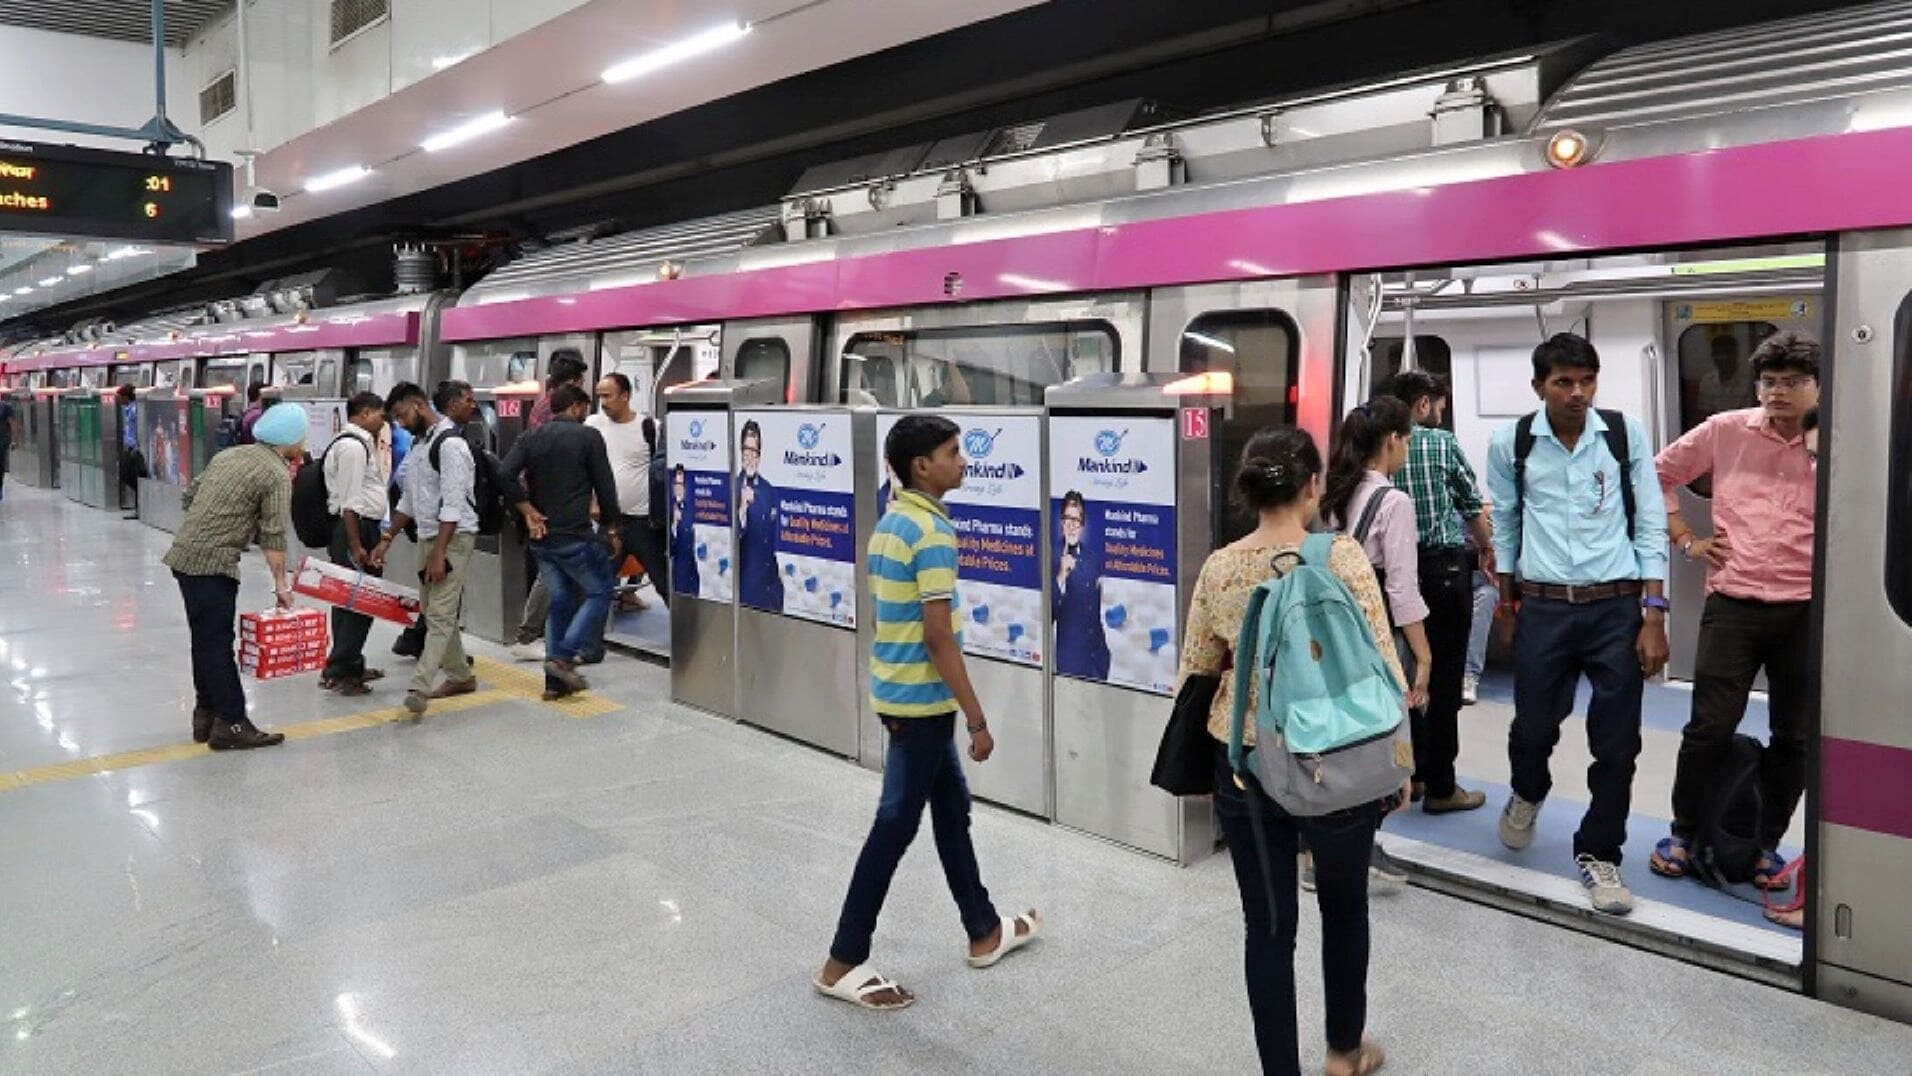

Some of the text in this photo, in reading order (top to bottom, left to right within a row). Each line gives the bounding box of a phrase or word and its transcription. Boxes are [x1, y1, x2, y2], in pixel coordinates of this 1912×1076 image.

[1185, 409, 1205, 436] 15
[783, 450, 828, 466] Mankind
[1077, 457, 1131, 473] Mankind
[963, 461, 1006, 478] nkind
[972, 518, 1003, 534] Pharma
